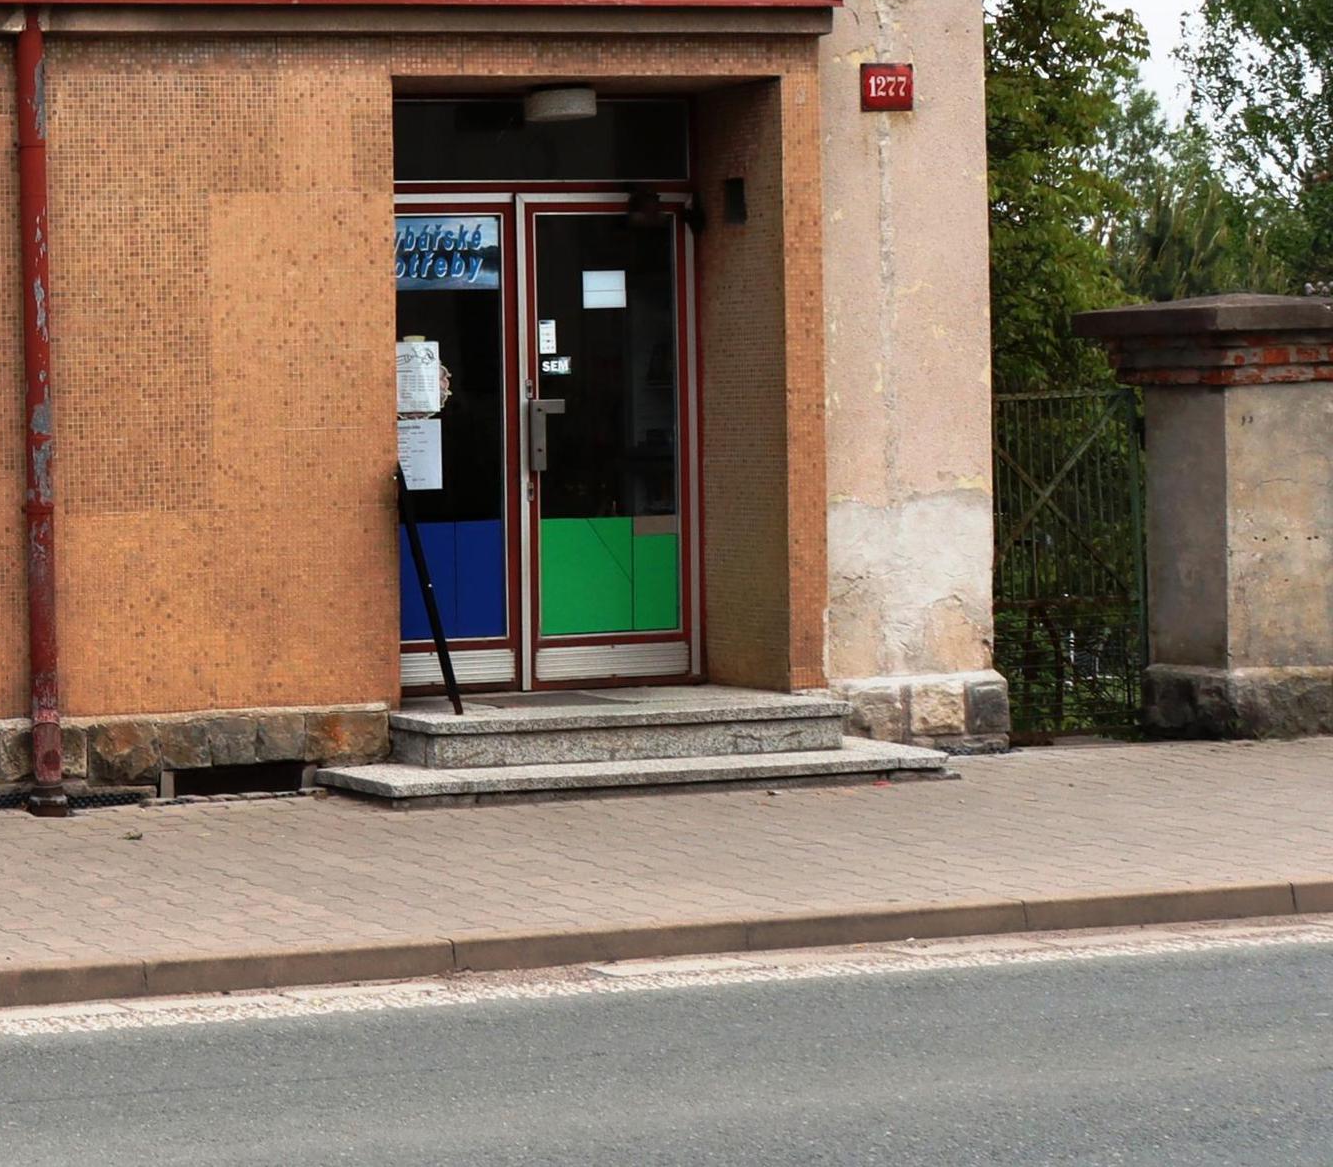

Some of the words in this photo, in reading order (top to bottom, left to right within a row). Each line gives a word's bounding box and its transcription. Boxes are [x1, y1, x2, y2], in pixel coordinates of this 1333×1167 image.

[868, 76, 907, 97] 1277
[394, 251, 484, 283] otřeby
[542, 359, 569, 372] SEM
